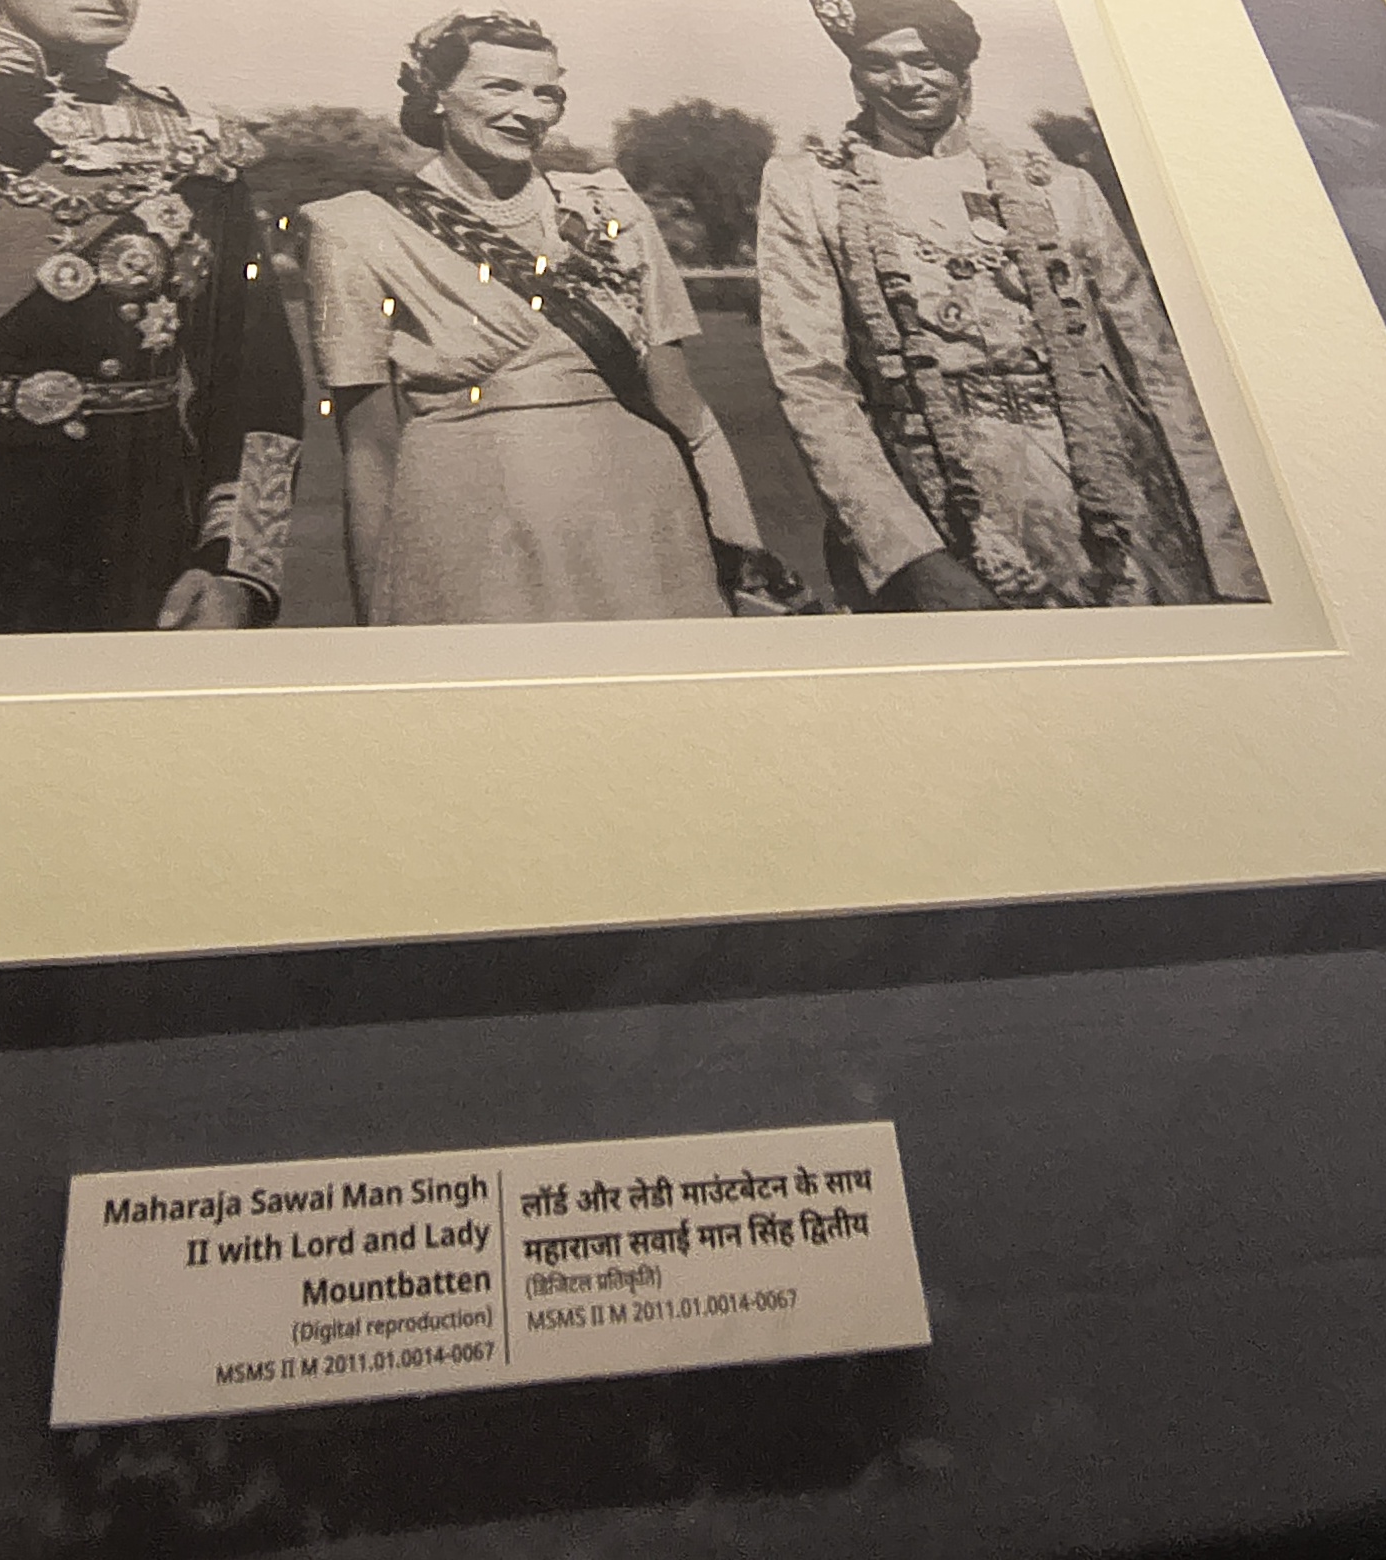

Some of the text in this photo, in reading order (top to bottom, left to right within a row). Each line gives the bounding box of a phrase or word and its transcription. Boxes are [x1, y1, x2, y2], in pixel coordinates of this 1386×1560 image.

[103, 1174, 489, 1227] Maharaja Sawai Man Singh
[520, 1165, 873, 1218] लॉर्ड और लेडी माउंटबेटन के साथ
[186, 1218, 492, 1267] II with Lord and Lady
[523, 1205, 870, 1267] महाराजा सवाई मान सिंह द्वितीय
[302, 1269, 492, 1307] Mountbatten
[292, 1305, 493, 1345] (Digital reproduction)
[527, 1305, 587, 1332] MSMS
[609, 1302, 628, 1325] M
[216, 1359, 276, 1386] MSMS
[301, 1357, 318, 1378] M
